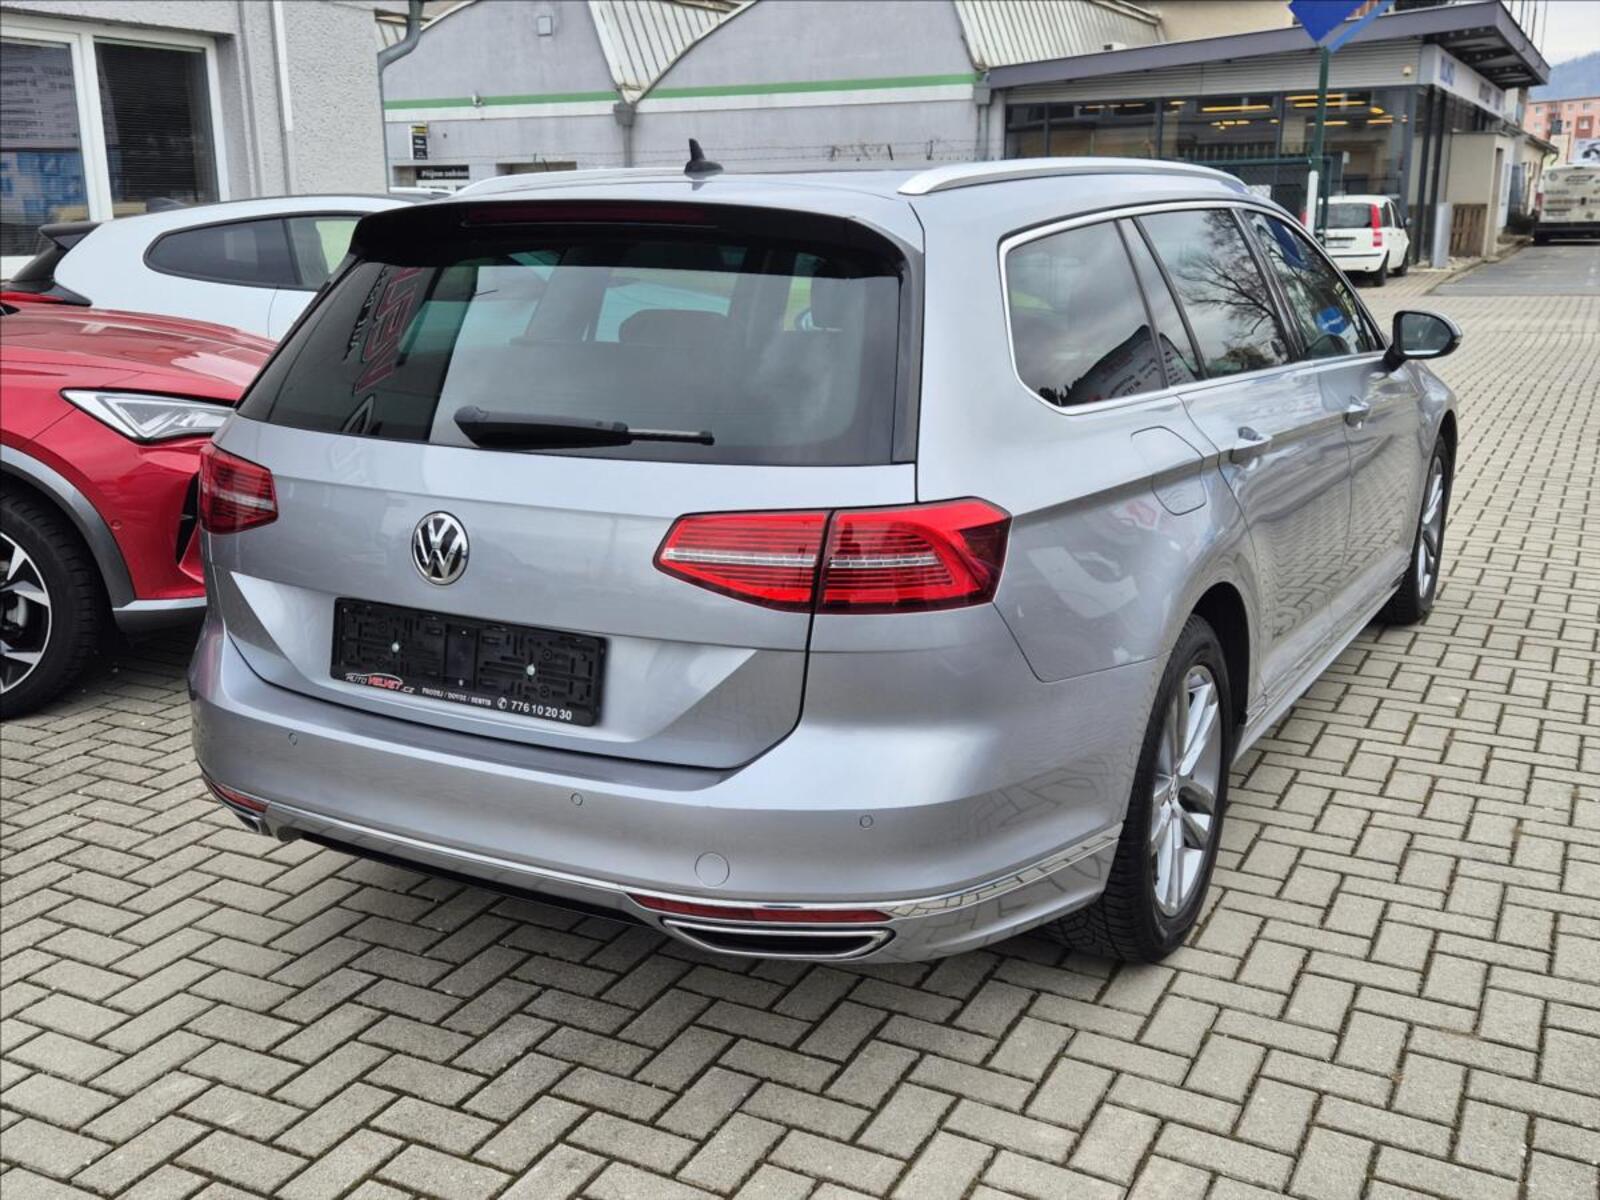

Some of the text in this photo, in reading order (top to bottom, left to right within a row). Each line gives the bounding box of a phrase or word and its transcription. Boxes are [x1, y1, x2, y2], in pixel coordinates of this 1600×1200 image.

[511, 700, 573, 721] 776 10 20 30
